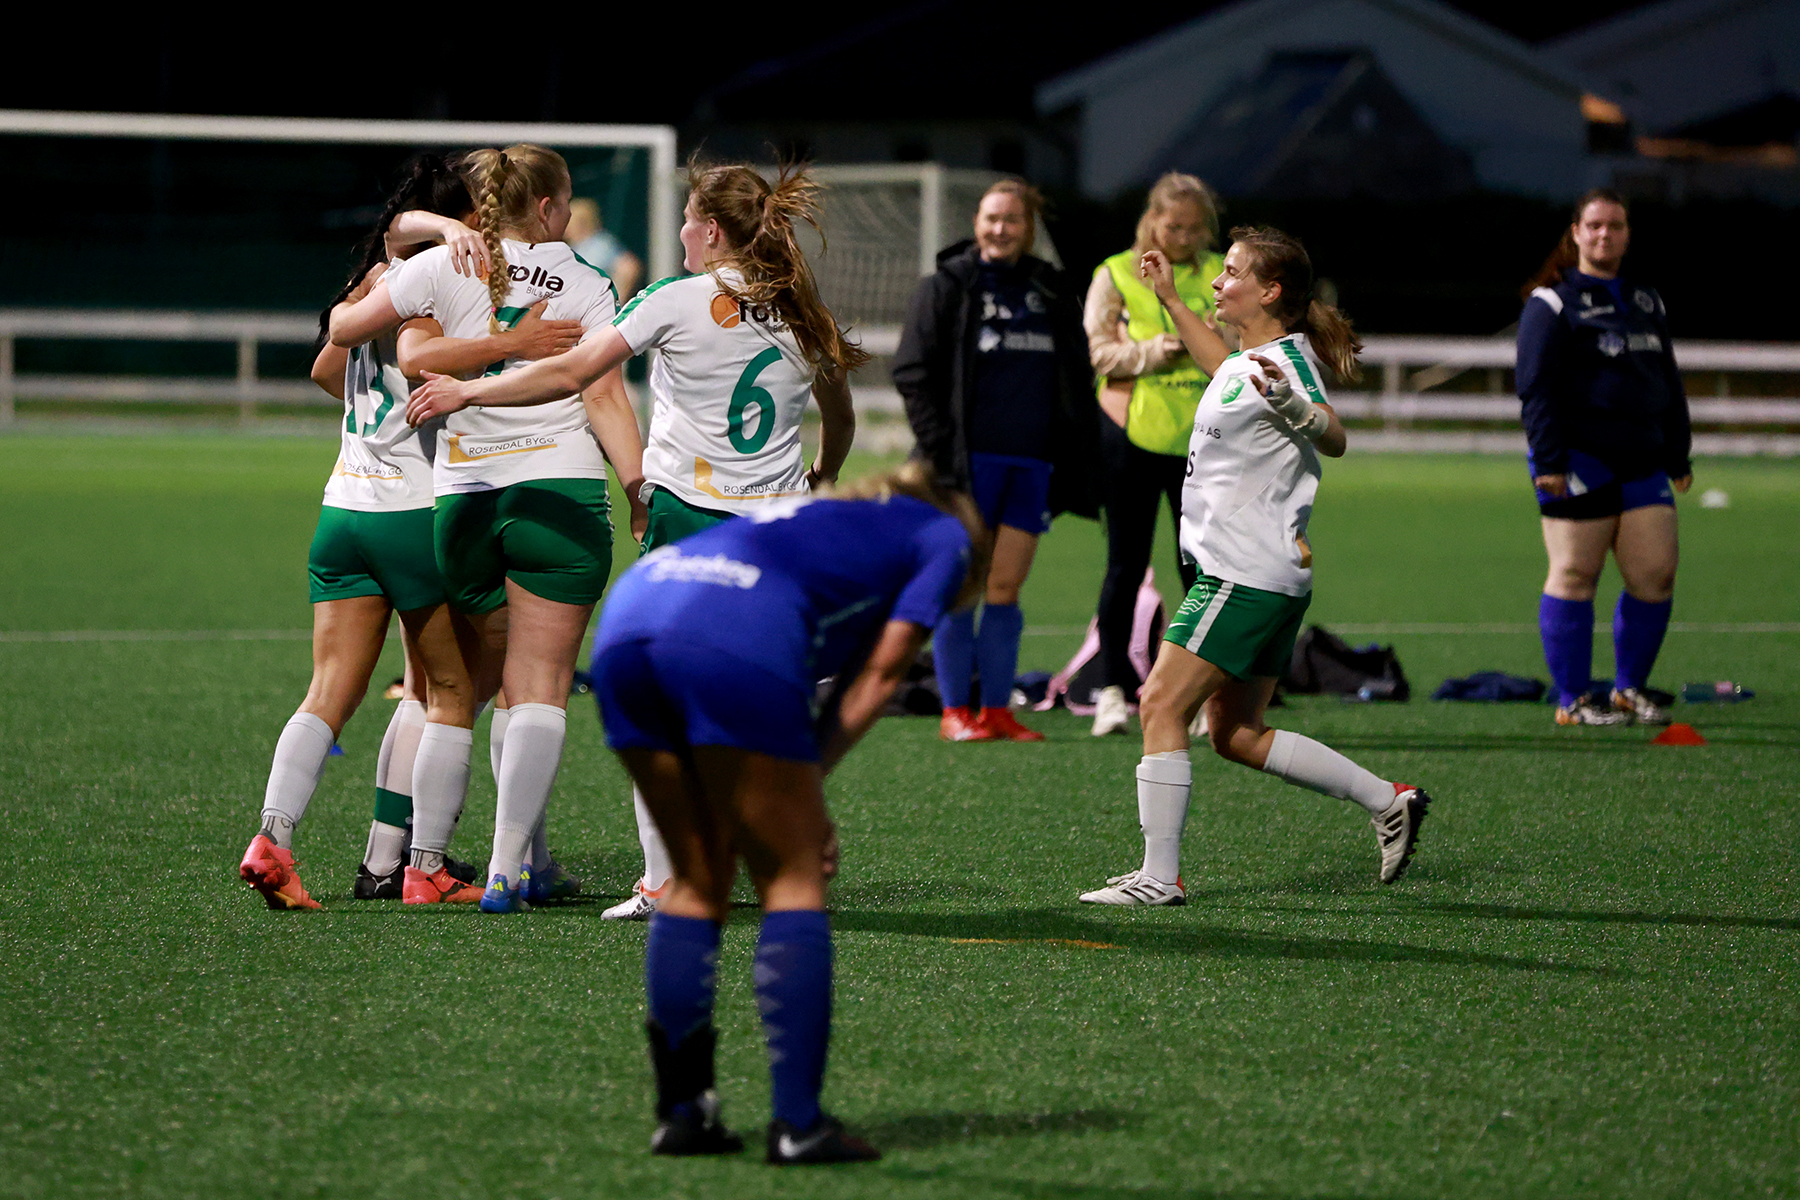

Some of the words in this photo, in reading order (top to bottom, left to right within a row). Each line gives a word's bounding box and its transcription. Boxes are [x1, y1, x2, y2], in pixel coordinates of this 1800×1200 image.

[727, 345, 783, 455] 6
[1206, 426, 1222, 440] AS
[468, 440, 523, 457] ROSENDAL
[723, 483, 777, 495] ROSENDAL
